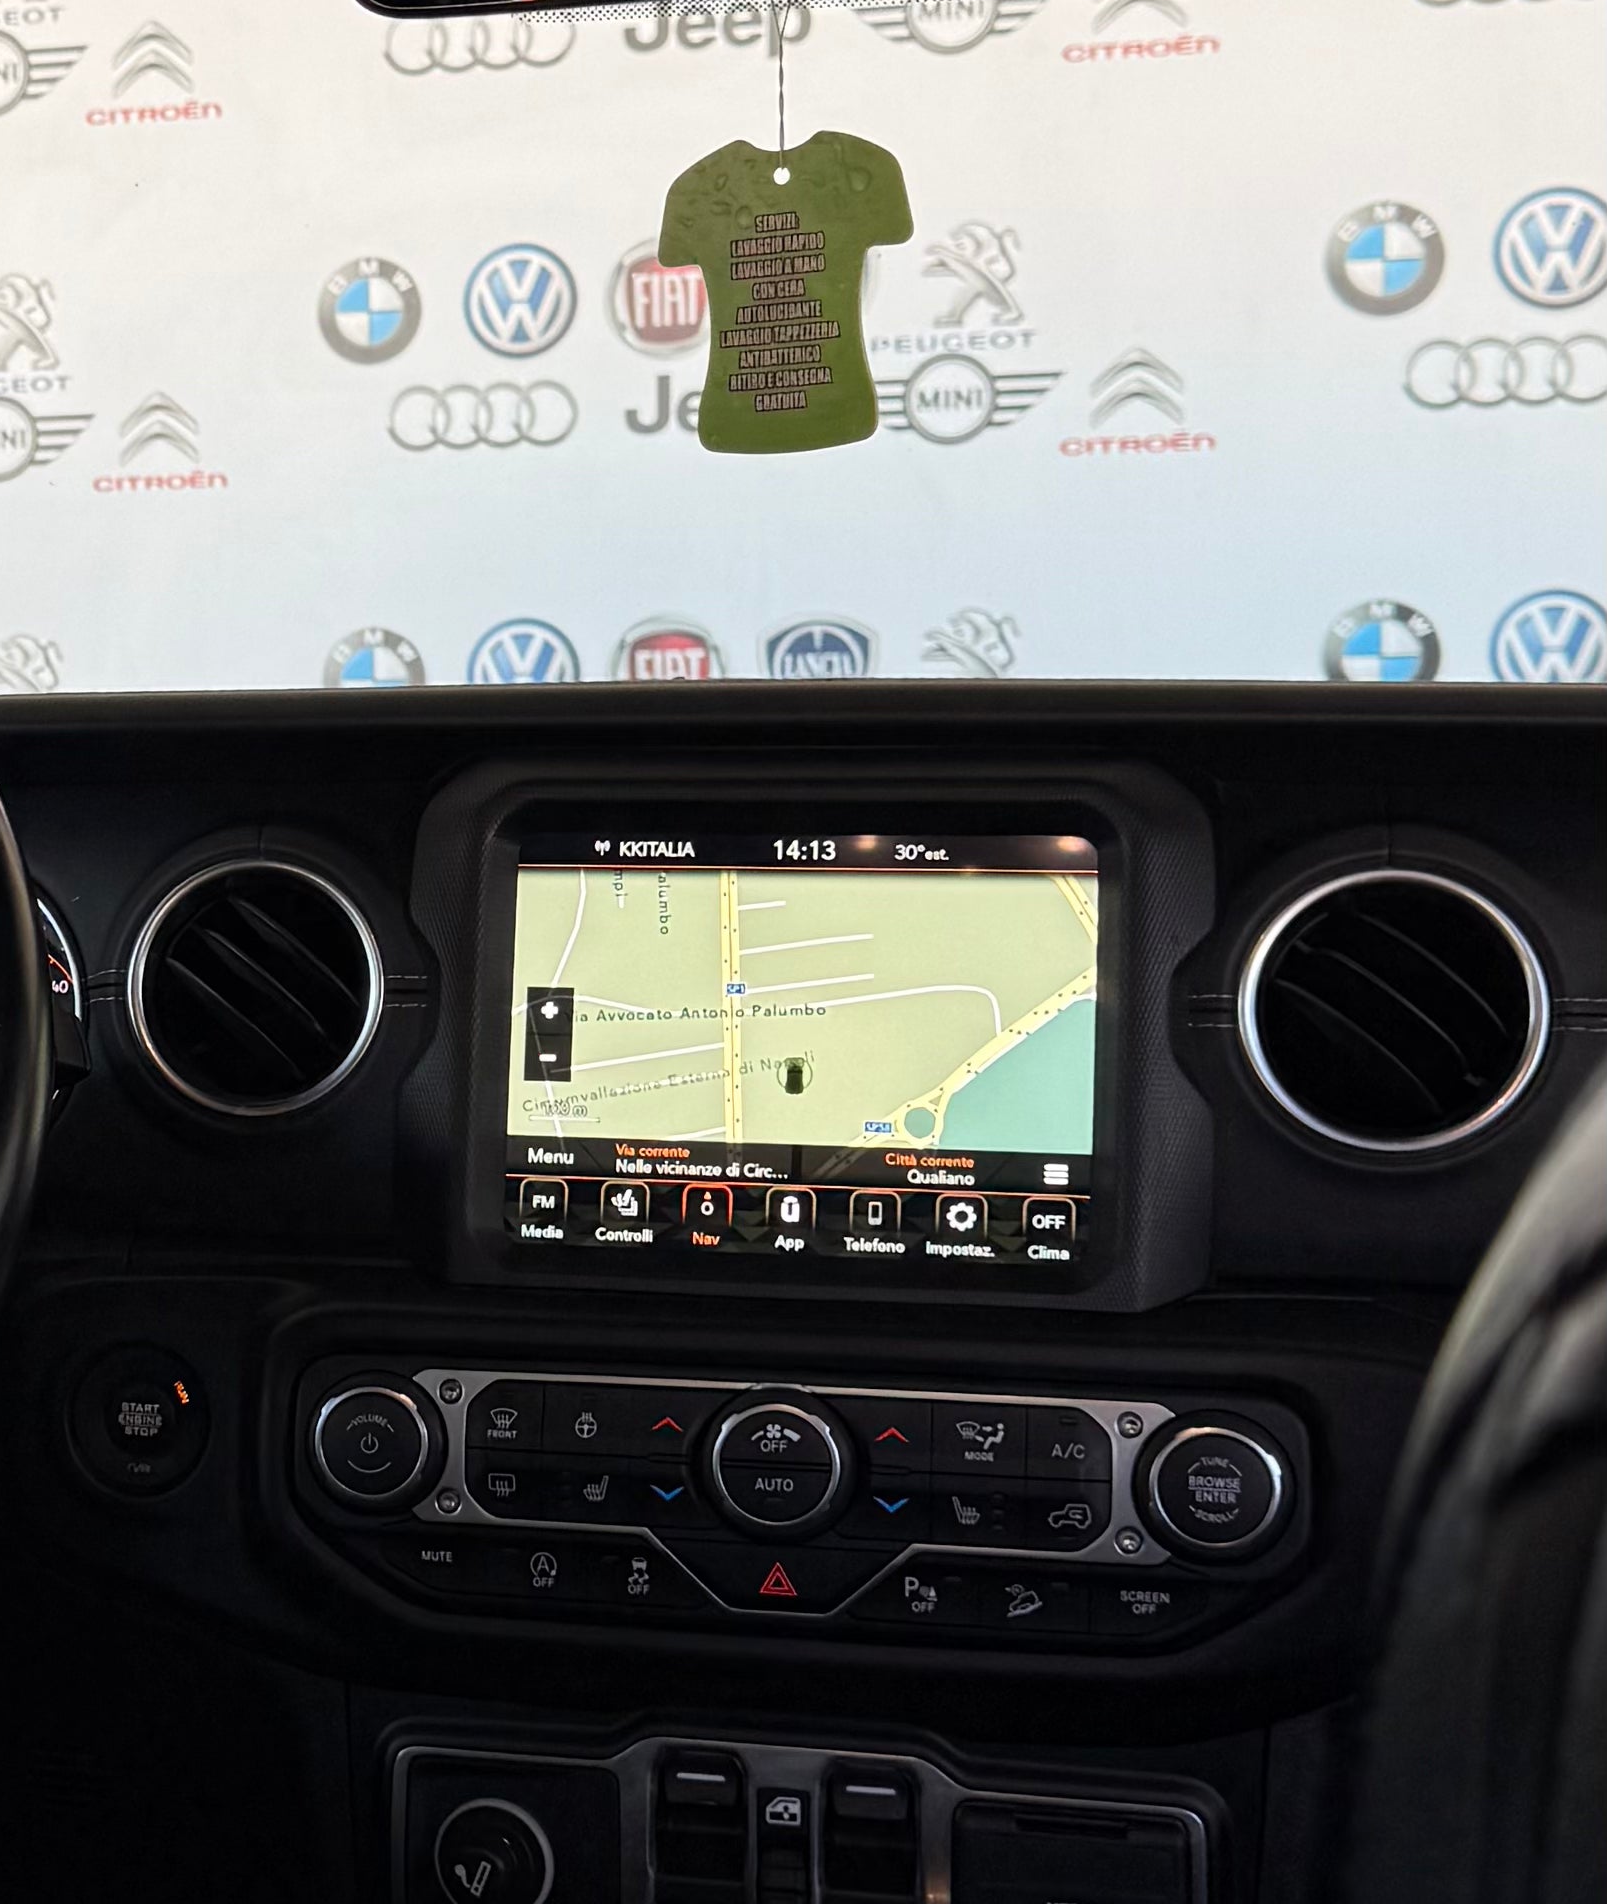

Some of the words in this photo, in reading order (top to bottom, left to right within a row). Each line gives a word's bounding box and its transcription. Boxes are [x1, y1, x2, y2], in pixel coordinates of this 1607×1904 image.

[918, 0, 986, 23] MINI
[624, 1, 812, 57] Jeep
[730, 258, 783, 280] LAVAGGIO
[631, 272, 705, 329] FIAT
[870, 328, 1037, 356] PEUGEOT
[624, 374, 701, 436] Je
[916, 387, 985, 414] MINI
[619, 841, 695, 858] KKITALIA
[772, 839, 836, 861] 14:13
[51, 979, 70, 994] 40
[596, 1008, 673, 1022] Avvocato
[751, 1004, 827, 1018] Palumbo
[760, 1050, 815, 1072] Nali
[527, 1147, 574, 1165] Menu
[615, 1143, 637, 1158] Via
[639, 1146, 691, 1158] corrente
[615, 1159, 653, 1175] Nelle
[656, 1161, 723, 1178] vicinanze
[725, 1163, 741, 1178] di
[919, 1156, 975, 1169] corrente
[907, 1169, 975, 1186] Qualiano
[532, 1195, 555, 1209] FM
[1031, 1214, 1066, 1230] OFF
[520, 1224, 564, 1240] Media
[595, 1226, 654, 1243] Controlli
[692, 1231, 720, 1246] Nav
[774, 1234, 805, 1252] App
[843, 1236, 906, 1254] Telefono
[925, 1241, 996, 1259] Impostaz.
[1027, 1244, 1070, 1261] Clima
[121, 1402, 161, 1413] START
[118, 1413, 163, 1427] ENGINE
[351, 1413, 389, 1428] VOLUME
[124, 1426, 159, 1436] STOP
[486, 1428, 518, 1440] FRONT
[759, 1439, 789, 1454] OFF
[1050, 1442, 1087, 1460] A/C
[963, 1450, 995, 1463] MODE
[1200, 1456, 1230, 1469] TUNE
[754, 1476, 794, 1493] AUTO
[1187, 1475, 1242, 1490] BROWSE
[1194, 1490, 1237, 1504] ENTER
[1193, 1509, 1236, 1524] SCROLL
[420, 1549, 454, 1564] MUTE
[531, 1577, 556, 1590] OFF
[626, 1584, 651, 1597] OFF
[1119, 1589, 1171, 1605] SCREEN
[910, 1599, 936, 1615] OFF
[1131, 1602, 1157, 1616] OFF
